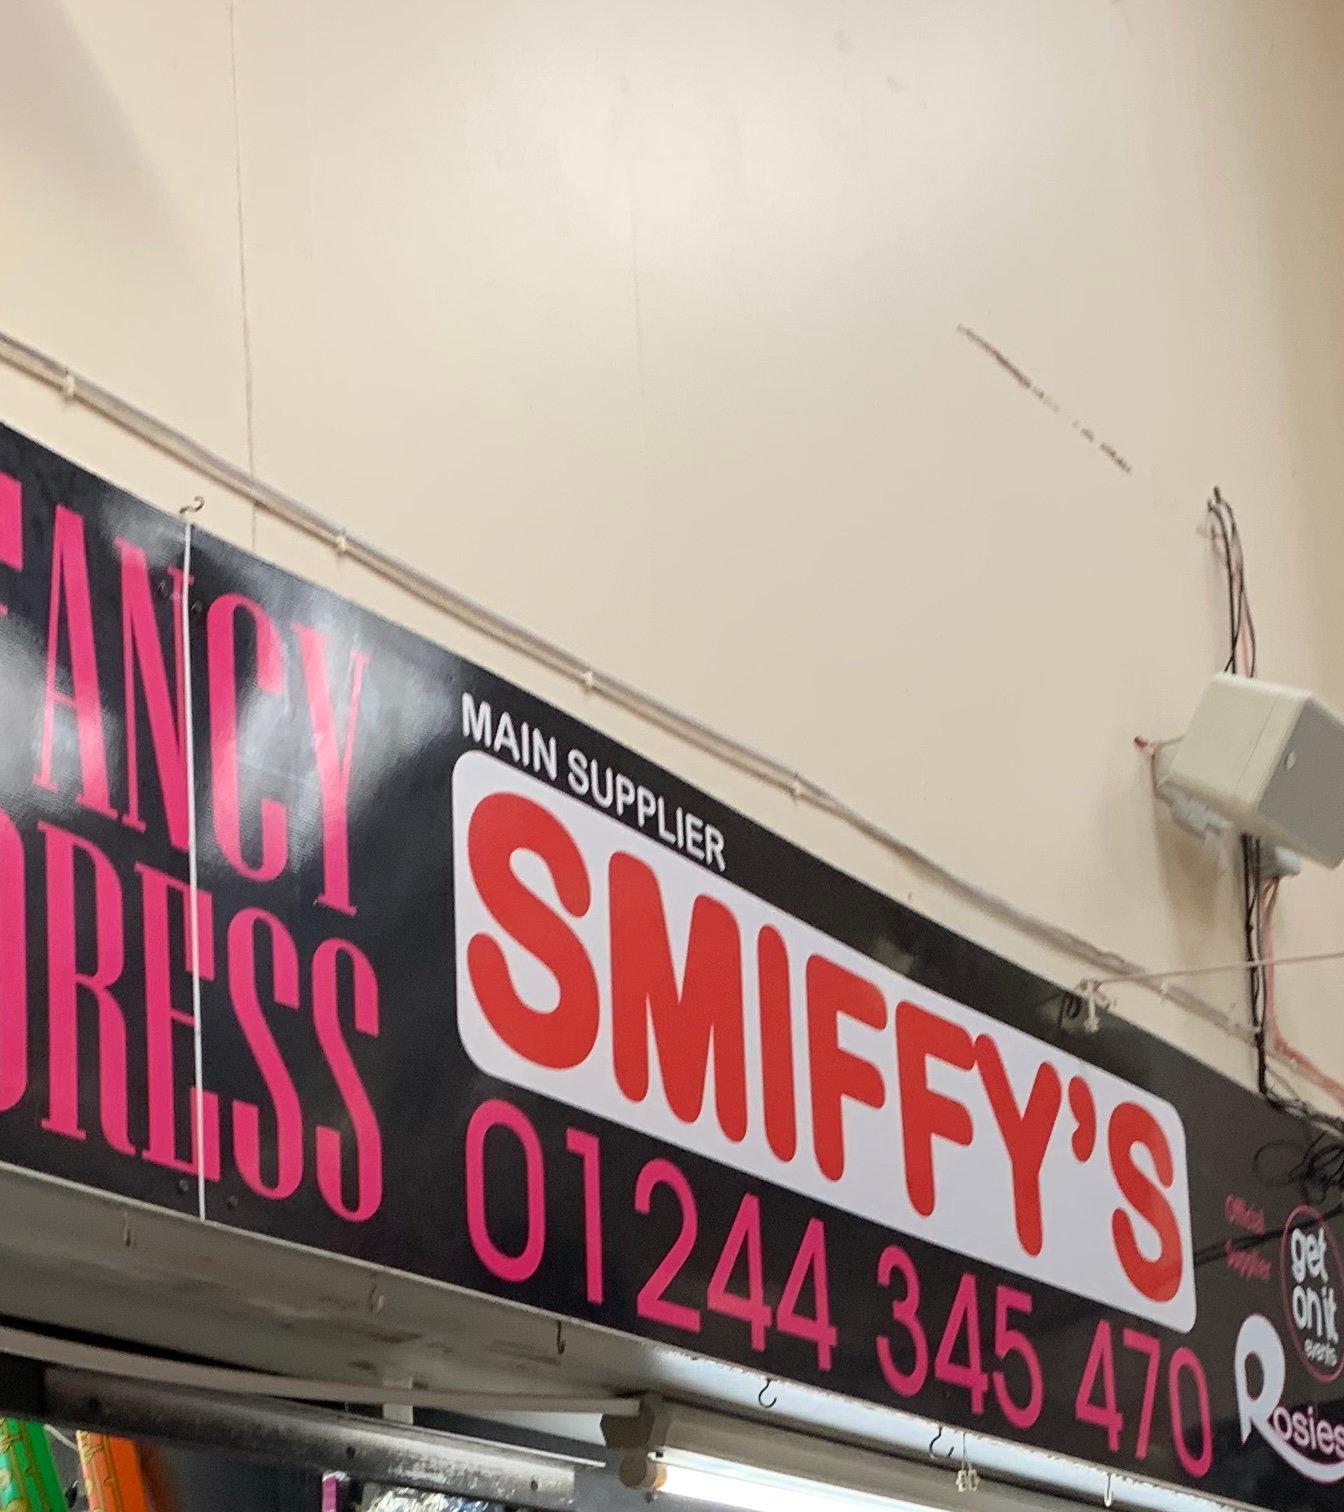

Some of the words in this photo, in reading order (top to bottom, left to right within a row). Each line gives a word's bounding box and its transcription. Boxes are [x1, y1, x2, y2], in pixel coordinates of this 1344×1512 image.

[461, 691, 558, 782] MAIN
[566, 749, 727, 873] SUPPLIER
[466, 790, 1185, 1303] SMIFFY'S
[465, 1098, 838, 1371] 01244
[876, 1243, 1045, 1431] 345
[1074, 1318, 1215, 1479] 470
[1290, 1227, 1330, 1284] get
